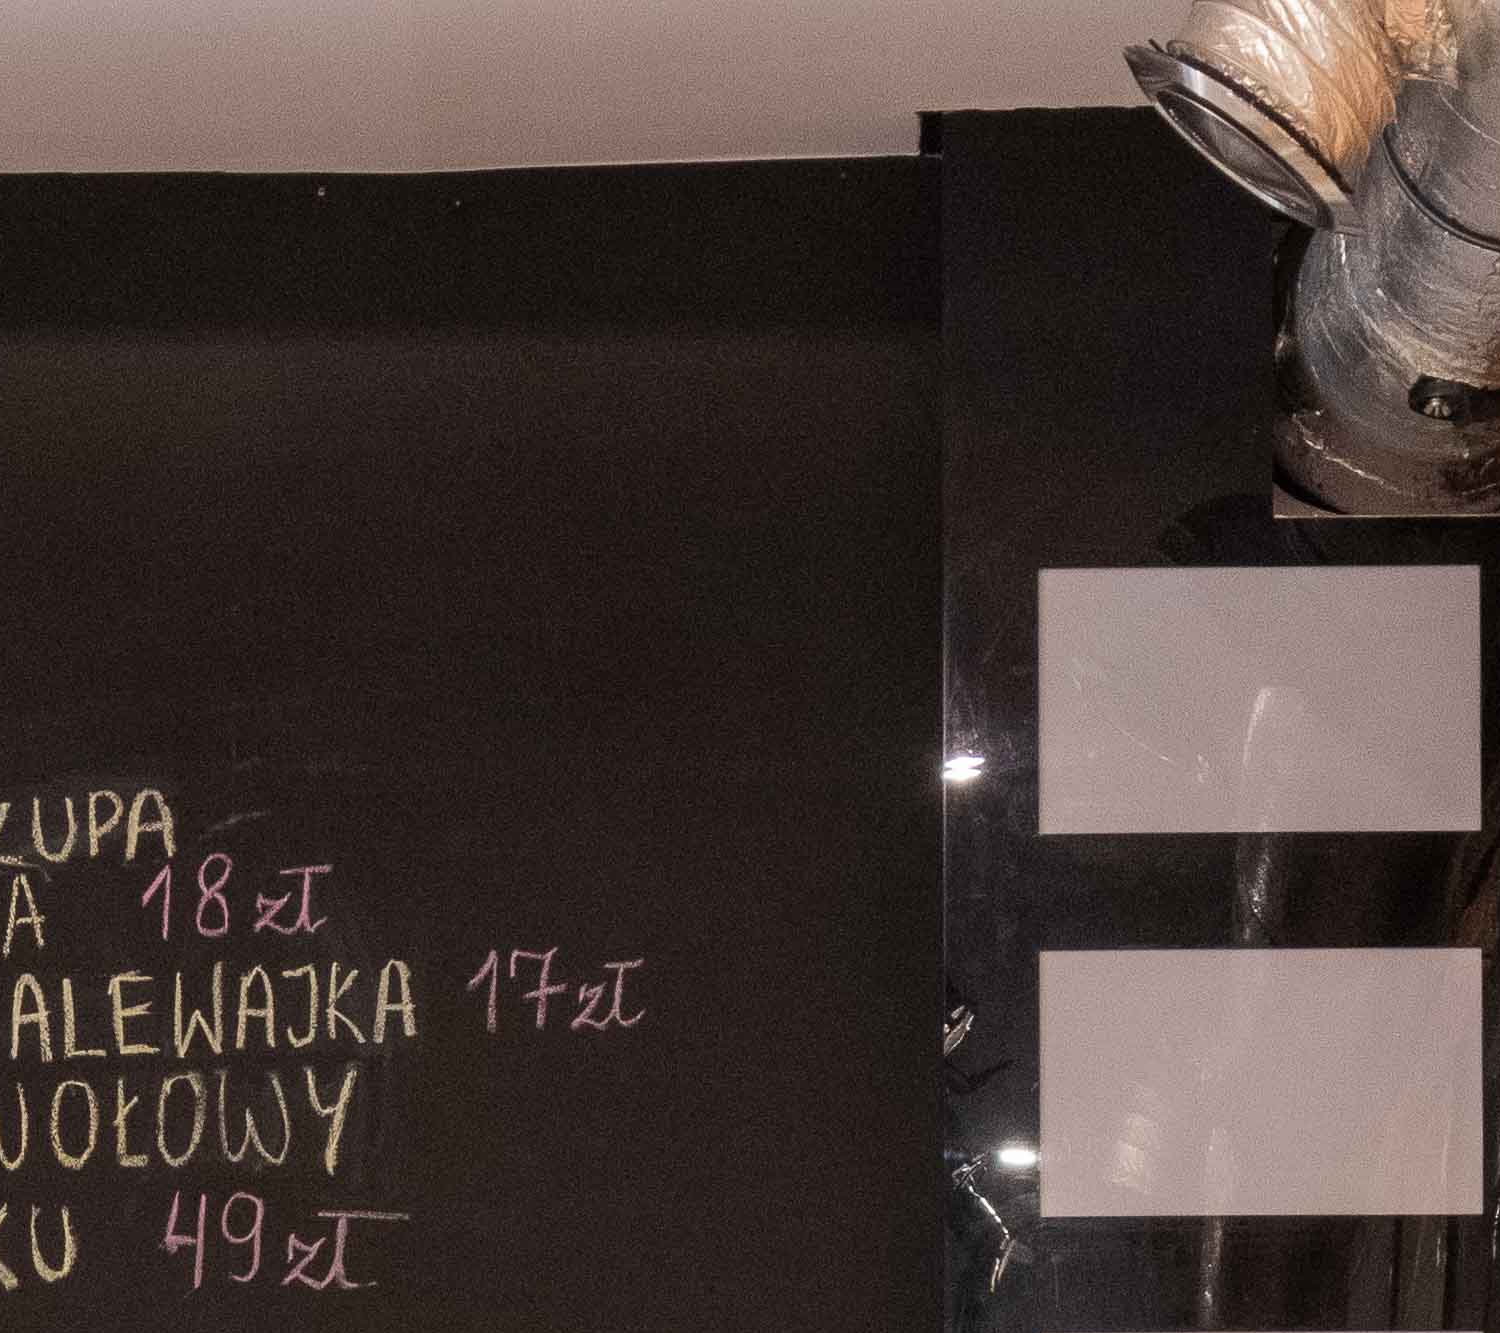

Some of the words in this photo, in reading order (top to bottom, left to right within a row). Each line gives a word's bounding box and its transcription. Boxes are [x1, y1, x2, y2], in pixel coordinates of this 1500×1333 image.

[141, 850, 232, 939] 18
[254, 865, 331, 935] zł
[469, 948, 566, 1030] 17
[571, 959, 644, 1029] zł
[164, 1191, 265, 1288] 49
[282, 1211, 408, 1290] zł
